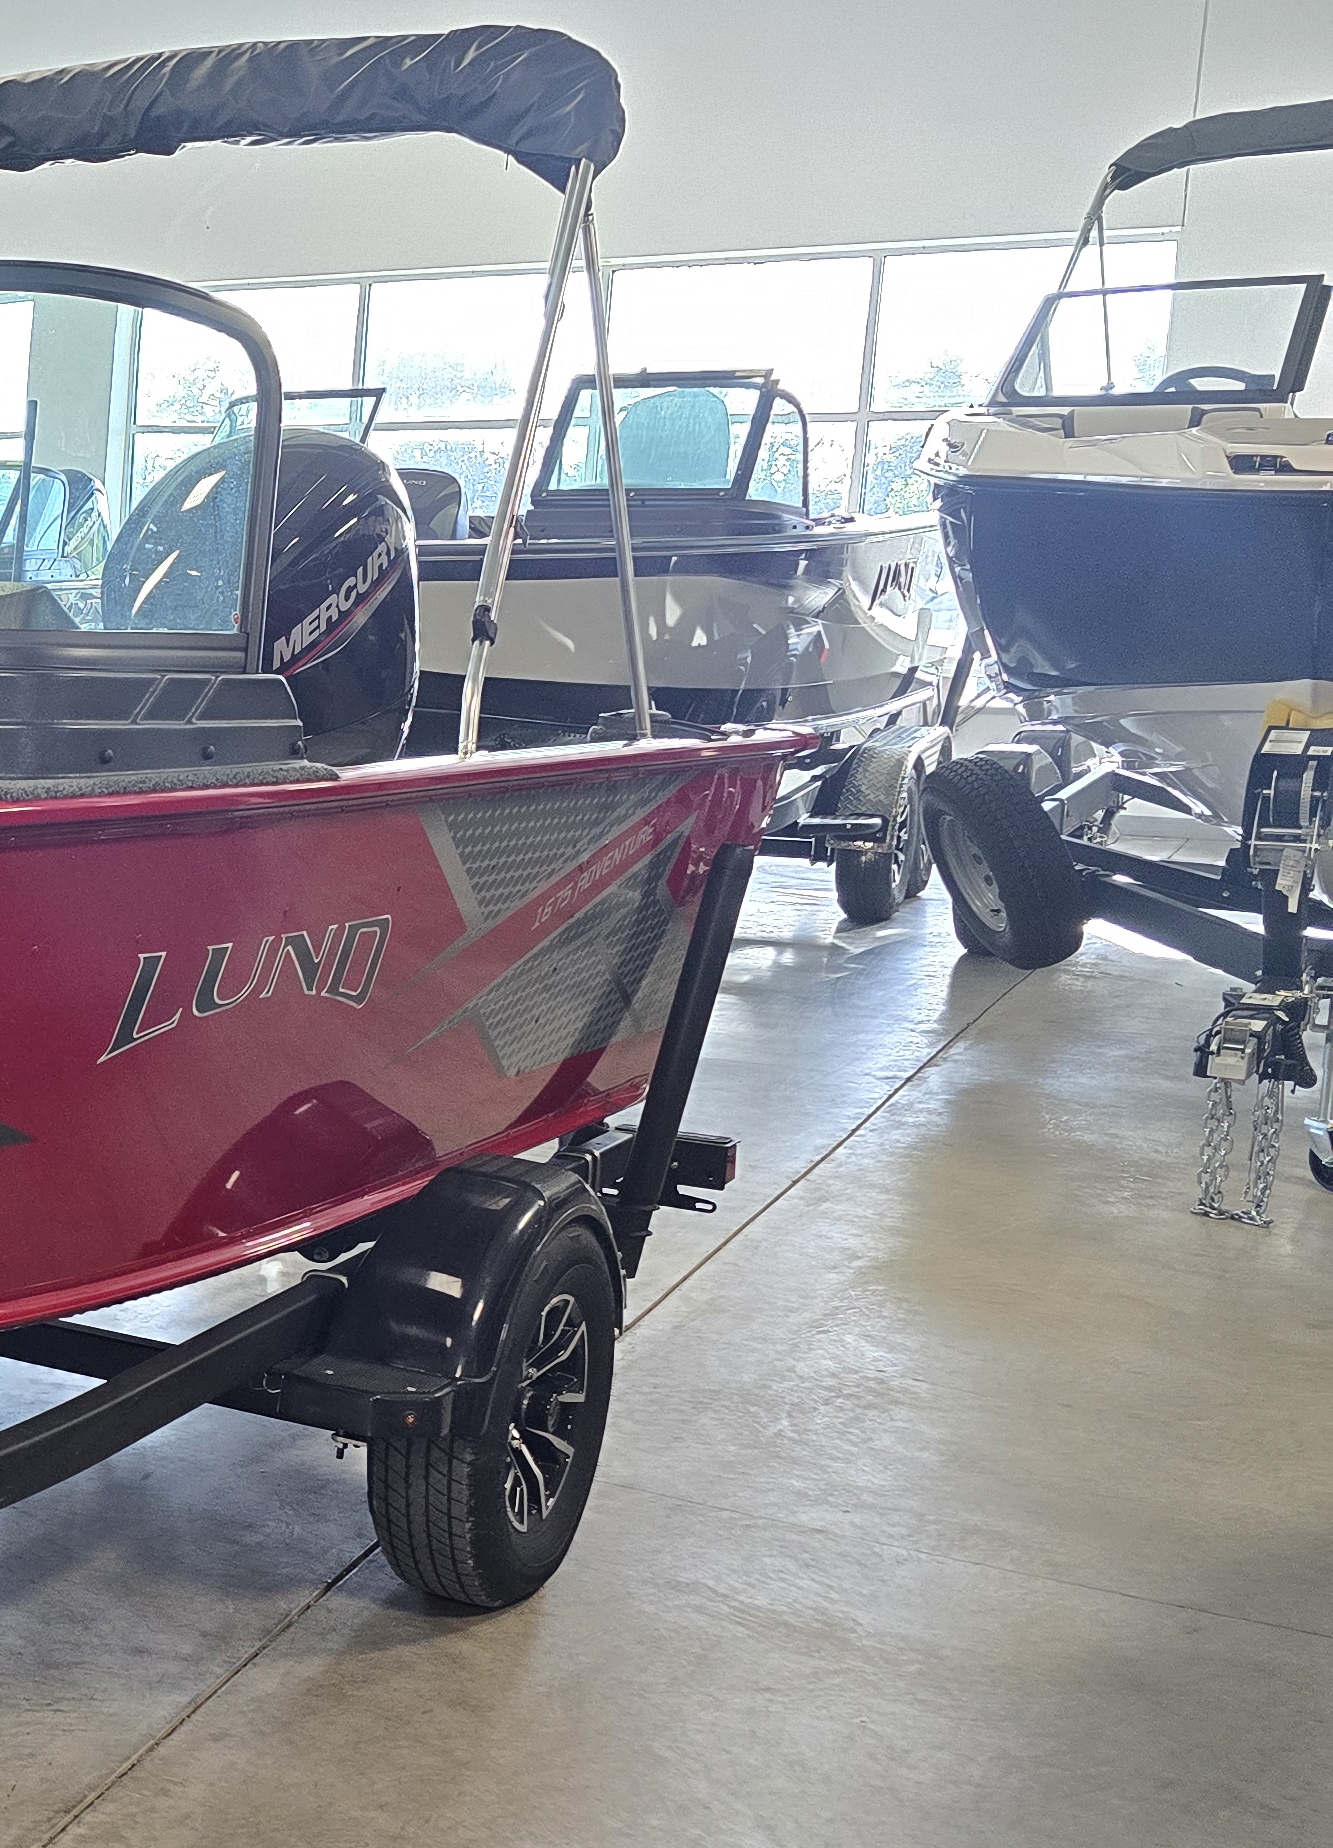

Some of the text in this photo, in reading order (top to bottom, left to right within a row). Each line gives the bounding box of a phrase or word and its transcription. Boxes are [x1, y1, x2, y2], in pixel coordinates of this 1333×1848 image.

[272, 524, 396, 671] MERCURY
[531, 818, 658, 931] 1675 ADVENTURE
[96, 914, 393, 1065] LUND
